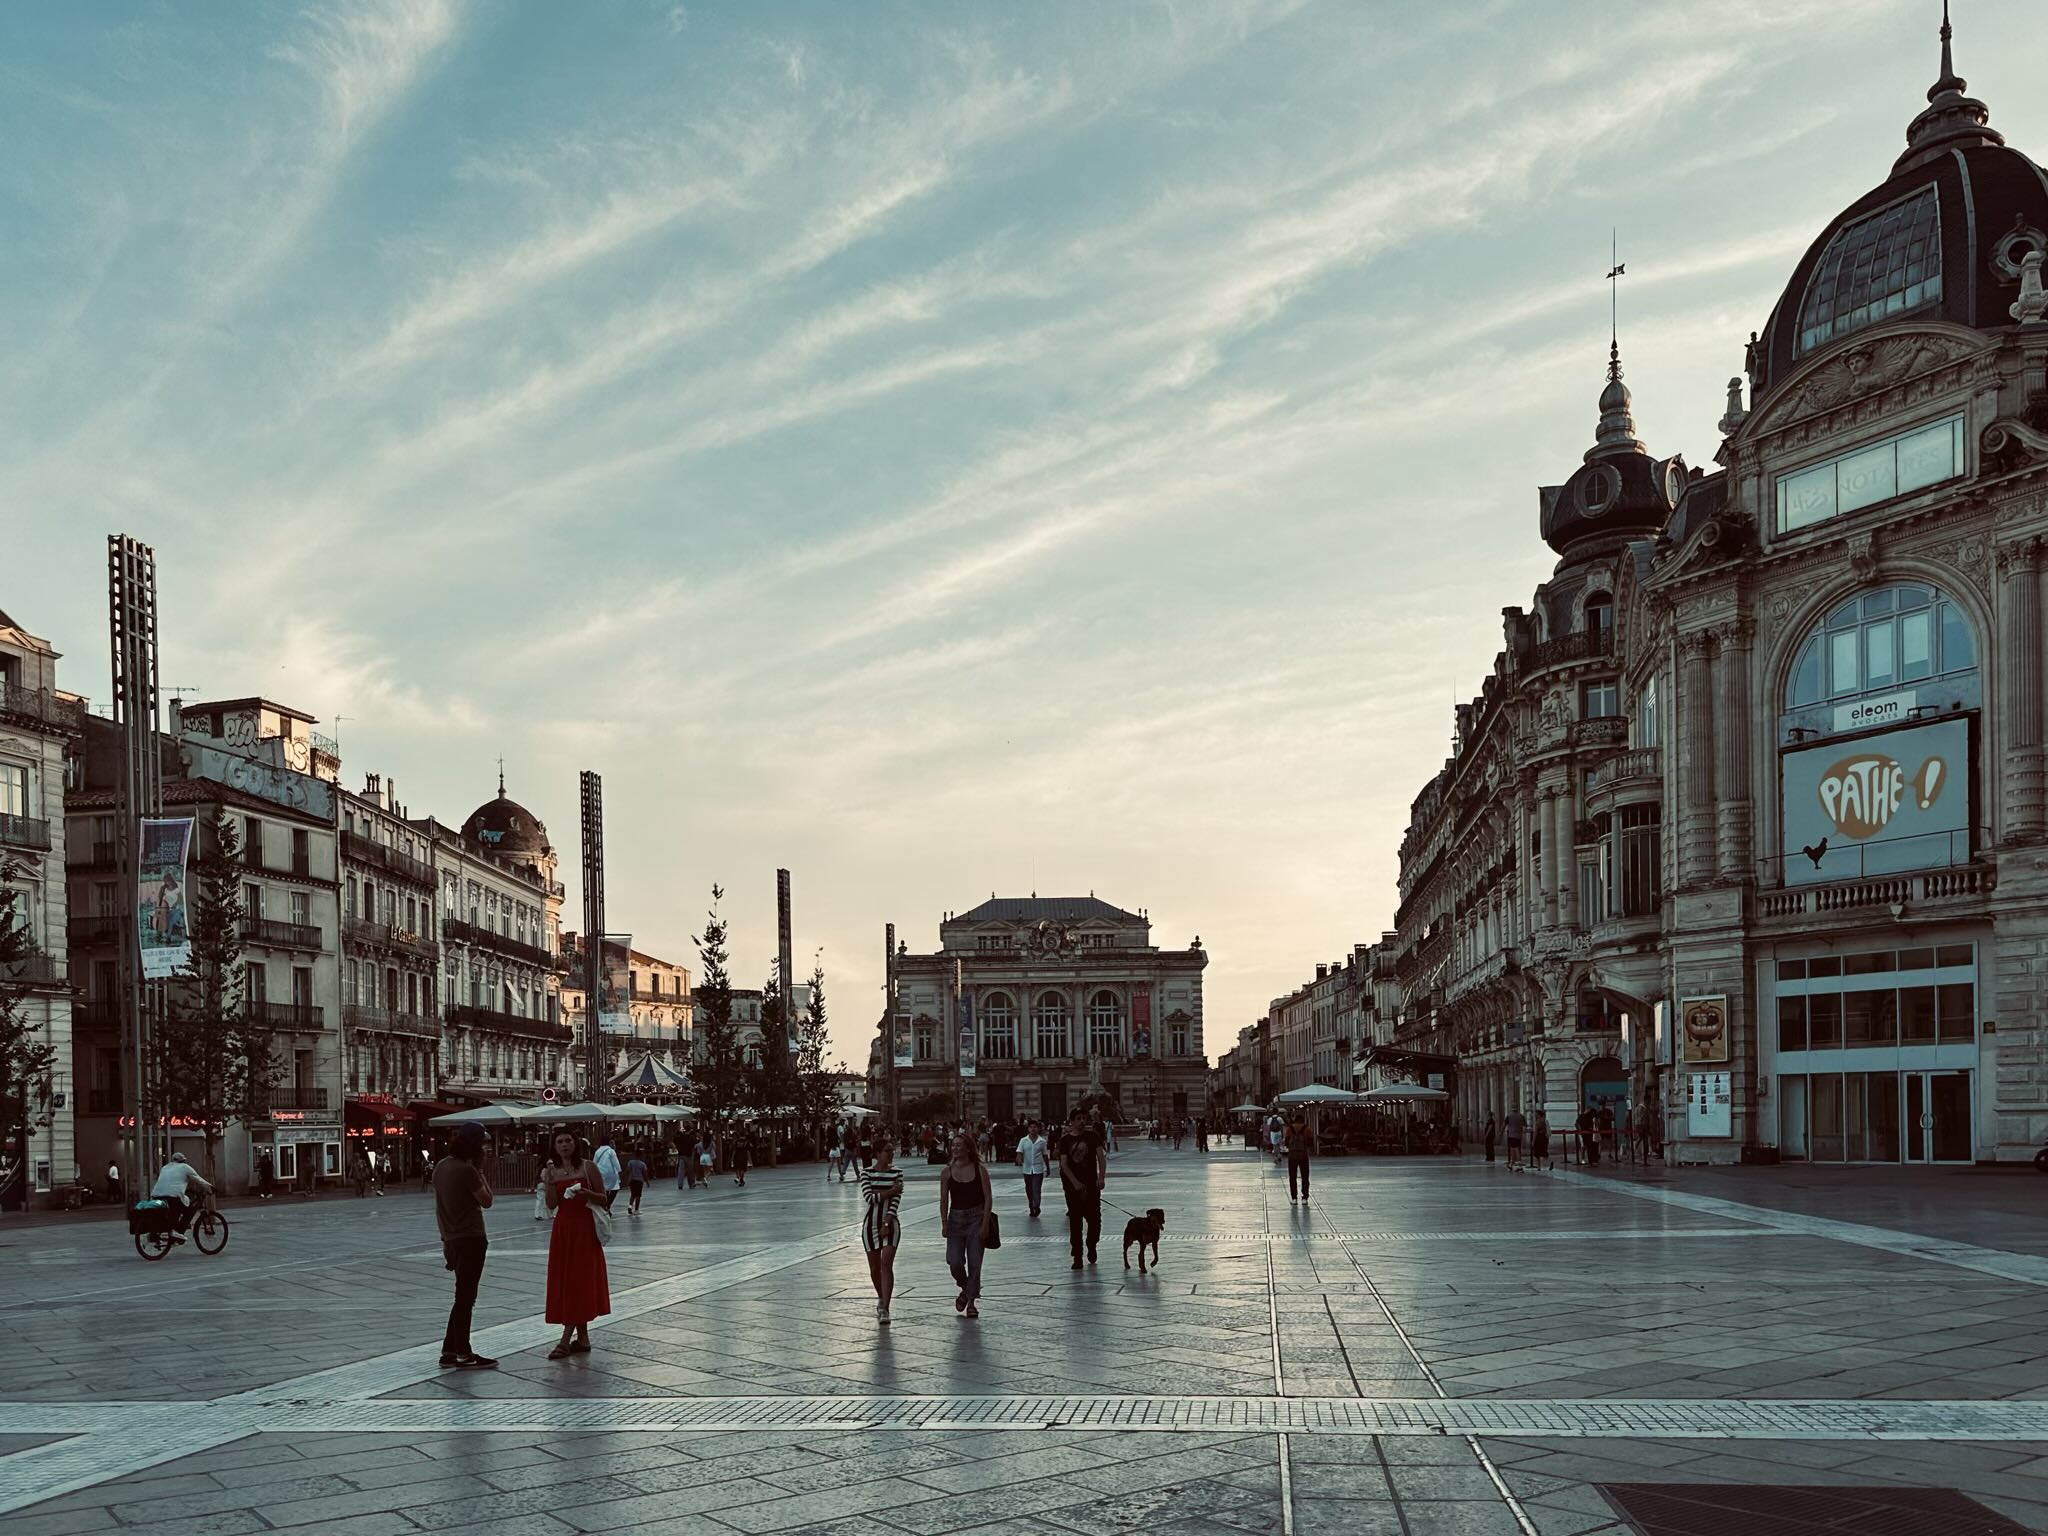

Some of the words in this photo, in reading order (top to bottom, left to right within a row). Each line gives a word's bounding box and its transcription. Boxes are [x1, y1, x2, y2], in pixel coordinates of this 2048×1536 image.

[1840, 447, 1941, 494] NOTARES
[1851, 701, 1898, 719] eleom
[1851, 712, 1898, 727] avocats
[1819, 760, 1904, 825] PATHÉ
